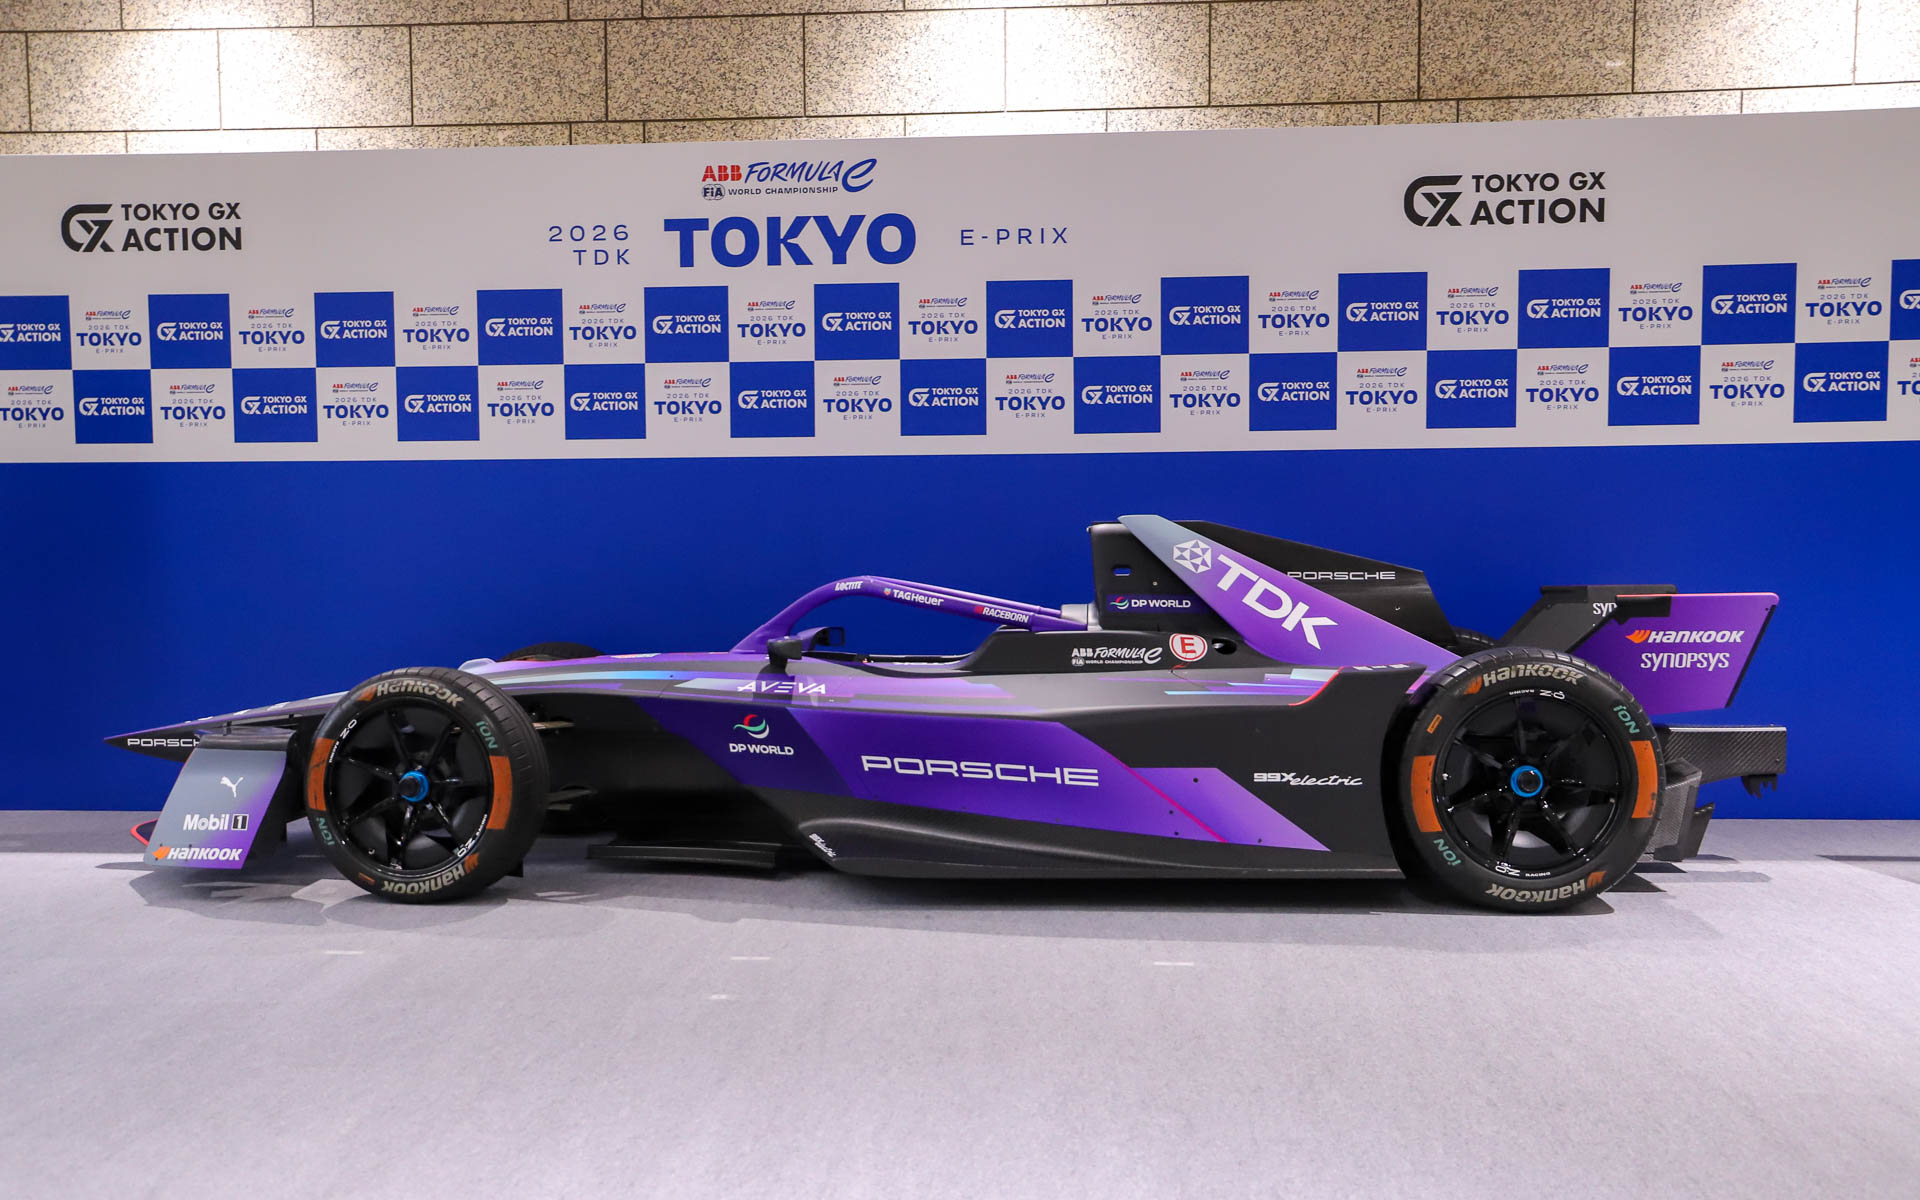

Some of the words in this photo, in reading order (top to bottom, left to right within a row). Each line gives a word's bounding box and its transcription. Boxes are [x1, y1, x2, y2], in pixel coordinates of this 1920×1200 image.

[702, 164, 743, 182] ABB
[744, 159, 845, 184] FORMULA
[1472, 173, 1560, 193] TOKYO
[1569, 172, 1606, 191] GX
[728, 187, 762, 196] WORLD
[765, 186, 839, 195] CHAMPIONSHIP
[121, 203, 200, 221] TOKYO
[209, 202, 242, 220] GX
[1470, 197, 1606, 226] ACTION
[548, 224, 629, 243] 2026
[960, 226, 1068, 246] E-PRIX
[122, 227, 243, 252] ACTION
[663, 212, 917, 269] TOKYO
[572, 248, 630, 266] TDK
[1551, 299, 1585, 307] TOKYO
[1586, 298, 1602, 306] GX
[1736, 294, 1771, 303] TOKYO
[1772, 294, 1788, 302] GX
[1017, 309, 1050, 317] TOKYO
[1051, 309, 1066, 317] GX
[1192, 306, 1225, 314] TOKYO
[1226, 305, 1241, 313] GX
[1551, 308, 1601, 318] ACTION
[1736, 303, 1787, 313] ACTION
[1805, 301, 1882, 317] TOKYO
[507, 318, 538, 326] TOKYO
[674, 315, 706, 323] TOKYO
[707, 315, 721, 323] GX
[1193, 315, 1240, 325] ACTION
[1436, 310, 1509, 325] TOKYO
[178, 322, 209, 330] TOKYO
[209, 322, 223, 330] GX
[1018, 318, 1065, 328] ACTION
[1081, 317, 1152, 332] TOKYO
[508, 326, 553, 336] ACTION
[675, 324, 721, 333] ACTION
[737, 323, 806, 338] TOKYO
[76, 332, 142, 346] TOKYO
[179, 331, 223, 340] ACTION
[403, 328, 470, 343] TOKYO
[1723, 375, 1749, 383] 2026
[1753, 375, 1772, 383] TDK
[1828, 372, 1864, 380] TOKYO
[1865, 371, 1881, 380] GX
[1458, 379, 1492, 387] TOKYO
[1494, 379, 1509, 387] GX
[1828, 381, 1880, 391] ACTION
[760, 390, 792, 398] TOKYO
[793, 390, 807, 398] GX
[1104, 385, 1137, 393] TOKYO
[1138, 385, 1153, 393] GX
[1459, 388, 1508, 398] ACTION
[1709, 383, 1785, 399] TOKYO
[100, 397, 130, 405] TOKYO
[131, 397, 145, 405] GX
[425, 394, 457, 402] TOKYO
[458, 394, 472, 402] GX
[1105, 394, 1152, 404] ACTION
[1345, 390, 1418, 405] TOKYO
[427, 403, 471, 412] ACTION
[654, 400, 722, 415] TOKYO
[761, 399, 807, 408] ACTION
[995, 396, 1065, 411] TOKYO
[101, 406, 145, 415] ACTION
[323, 404, 389, 419] TOKYO
[1287, 571, 1396, 580] PORSCHE
[1131, 599, 1148, 608] DP
[1149, 599, 1191, 608] WORLD
[1217, 554, 1338, 650] TDK
[982, 606, 1030, 624] RACEBORN
[1180, 636, 1197, 654] E
[1071, 647, 1094, 657] ABB
[1094, 646, 1146, 659] FORMULA
[737, 681, 826, 695] AVEVA
[127, 738, 200, 747] PORSC
[729, 743, 747, 753] DP
[747, 744, 794, 756] WORLD
[861, 755, 1099, 787] PORSCHE
[1289, 774, 1363, 786] electric
[183, 814, 230, 831] Mobil
